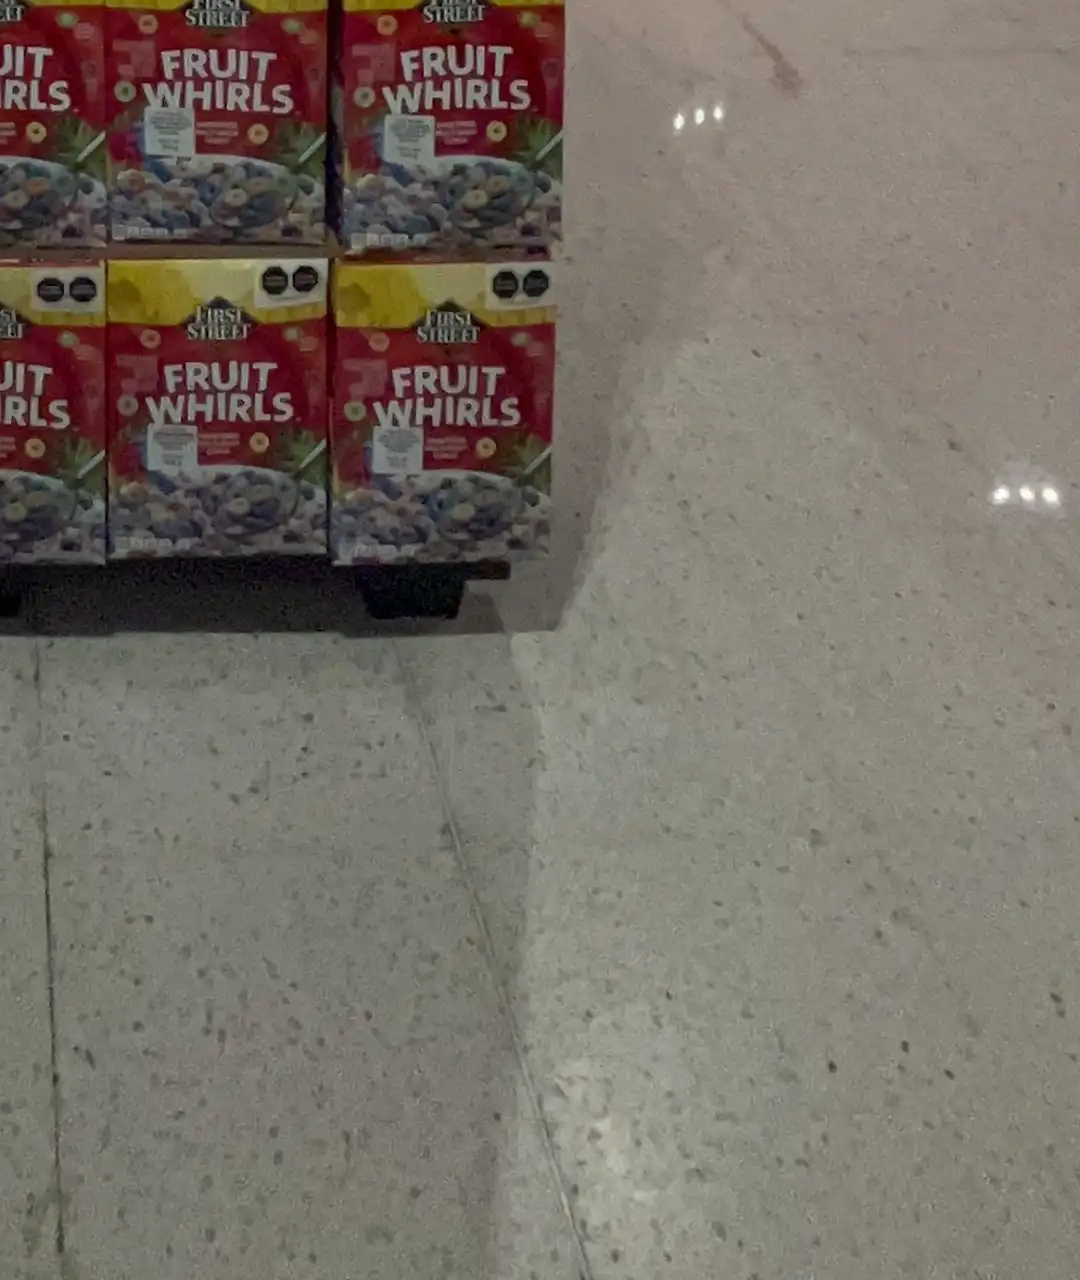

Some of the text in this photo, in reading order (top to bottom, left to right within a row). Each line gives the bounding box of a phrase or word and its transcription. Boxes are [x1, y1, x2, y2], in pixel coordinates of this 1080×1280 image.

[160, 48, 277, 82] FRUIT
[400, 44, 514, 82] FRUIT
[141, 79, 294, 115] WHIRLS
[381, 78, 531, 114] WHIRLS
[195, 306, 243, 324] FIRST
[425, 310, 472, 328] FIRST
[163, 360, 278, 394] FRUIT
[391, 364, 506, 398] FRUIT
[145, 390, 295, 425] WHIRLS
[372, 395, 520, 429] WHIRLS
